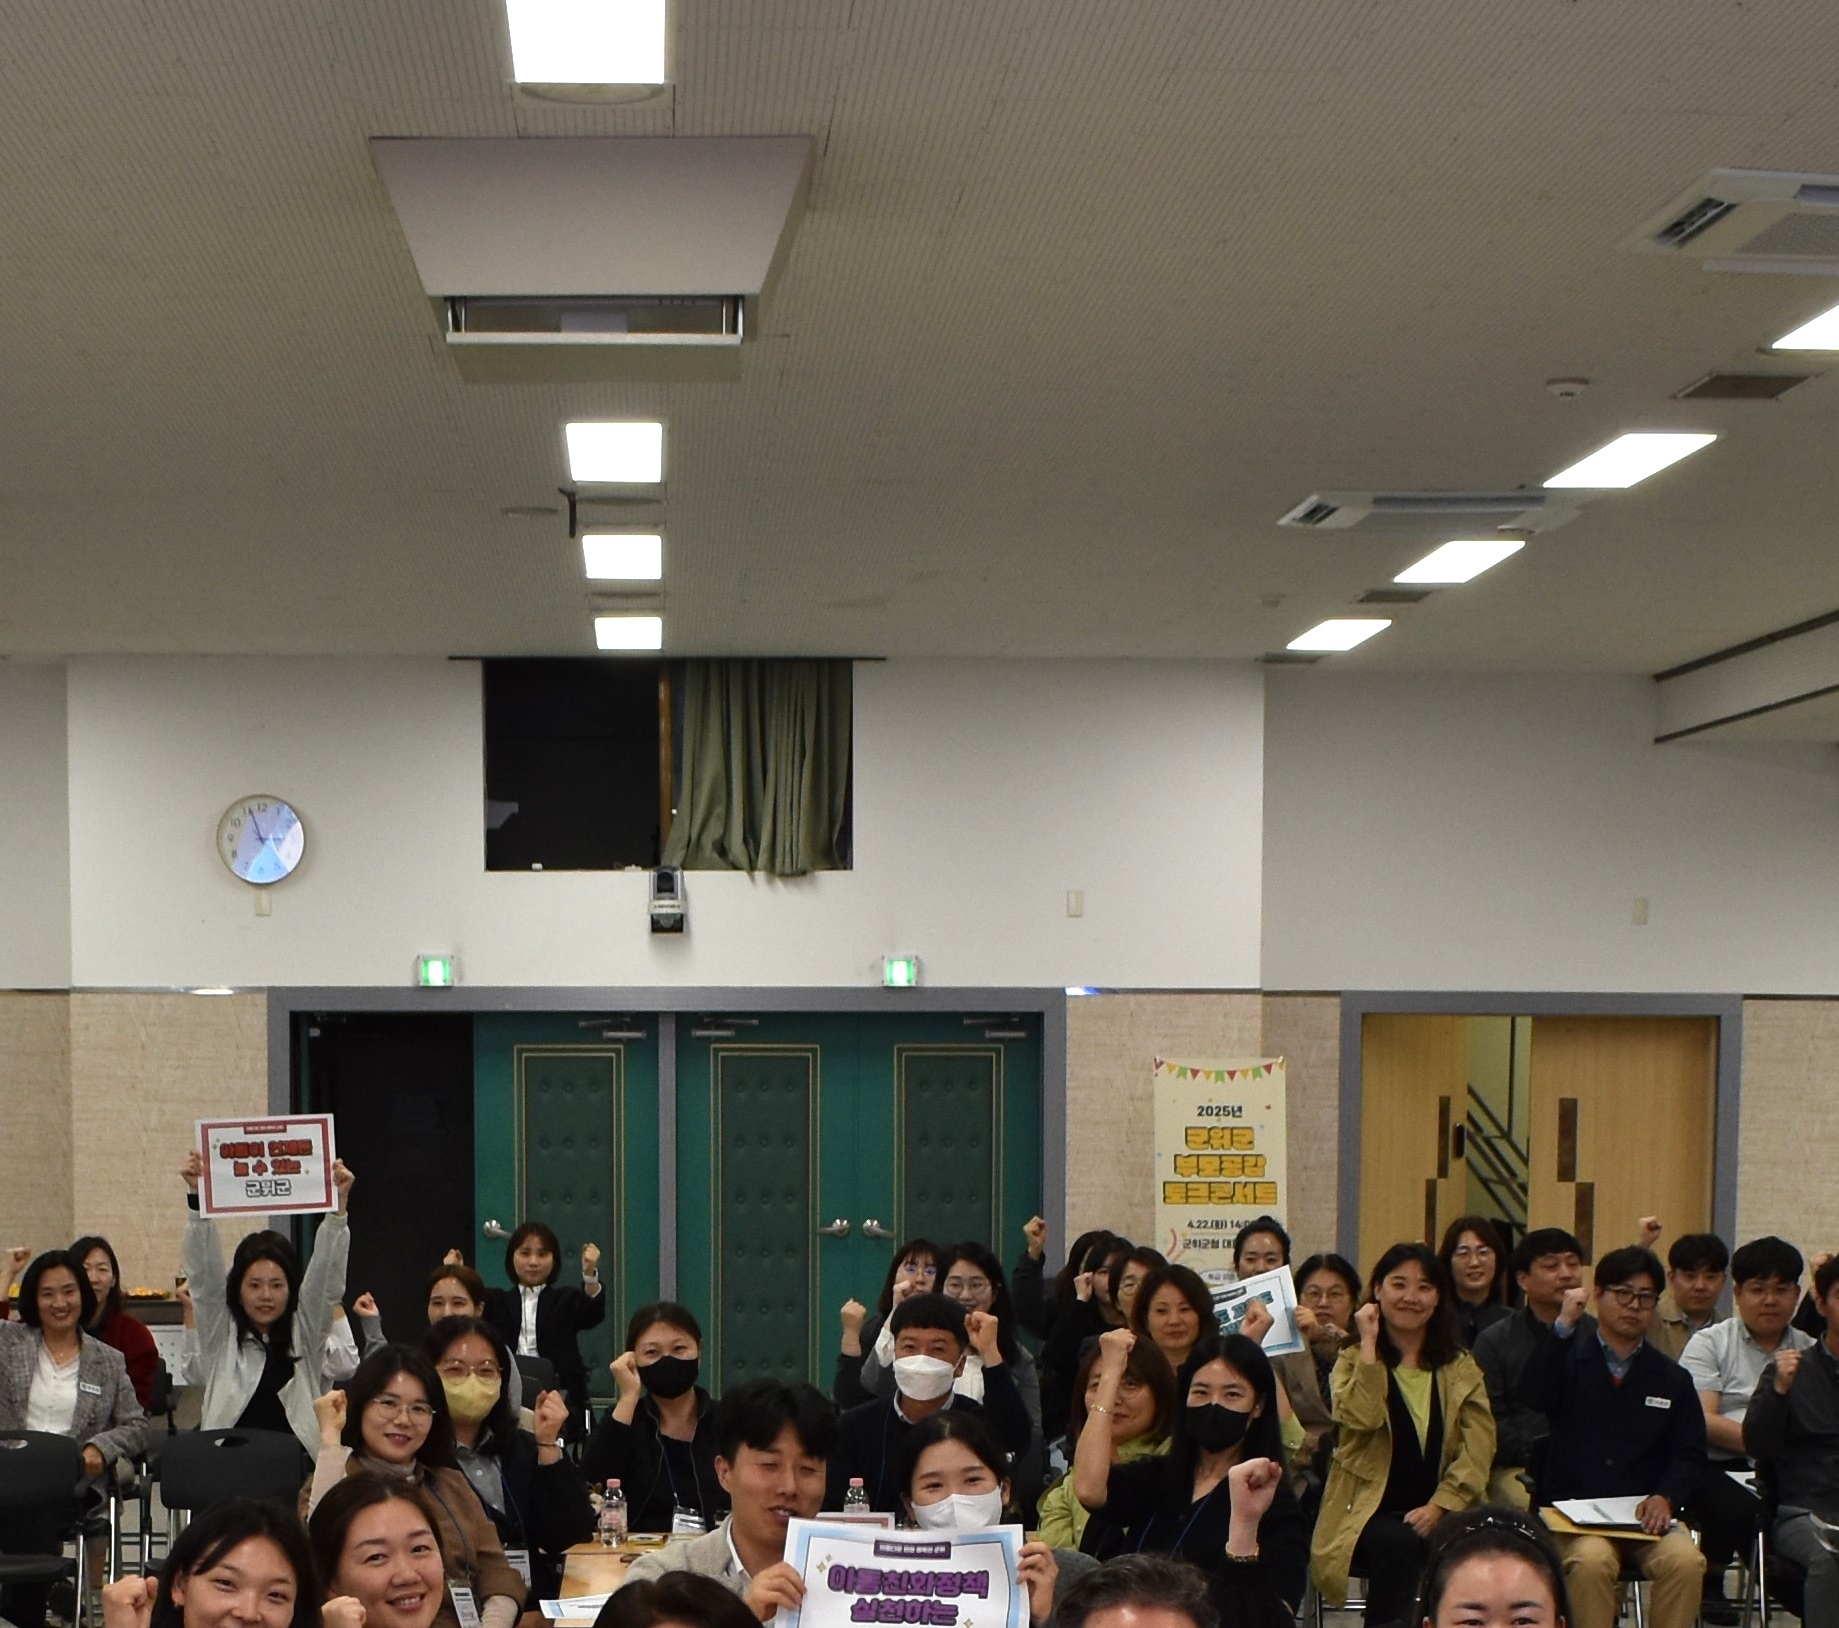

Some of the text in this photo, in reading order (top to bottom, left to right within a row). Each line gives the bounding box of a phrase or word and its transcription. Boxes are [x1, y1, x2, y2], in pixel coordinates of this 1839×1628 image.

[1197, 1105, 1243, 1118] 2025년
[1185, 1126, 1255, 1150] 군위군
[1174, 1154, 1267, 1177] 부모공감
[245, 1178, 292, 1198] 군위군
[1163, 1181, 1277, 1205] 토크콘서트
[827, 1564, 989, 1599] 아동친화정책
[851, 1598, 959, 1626] 실천하는
